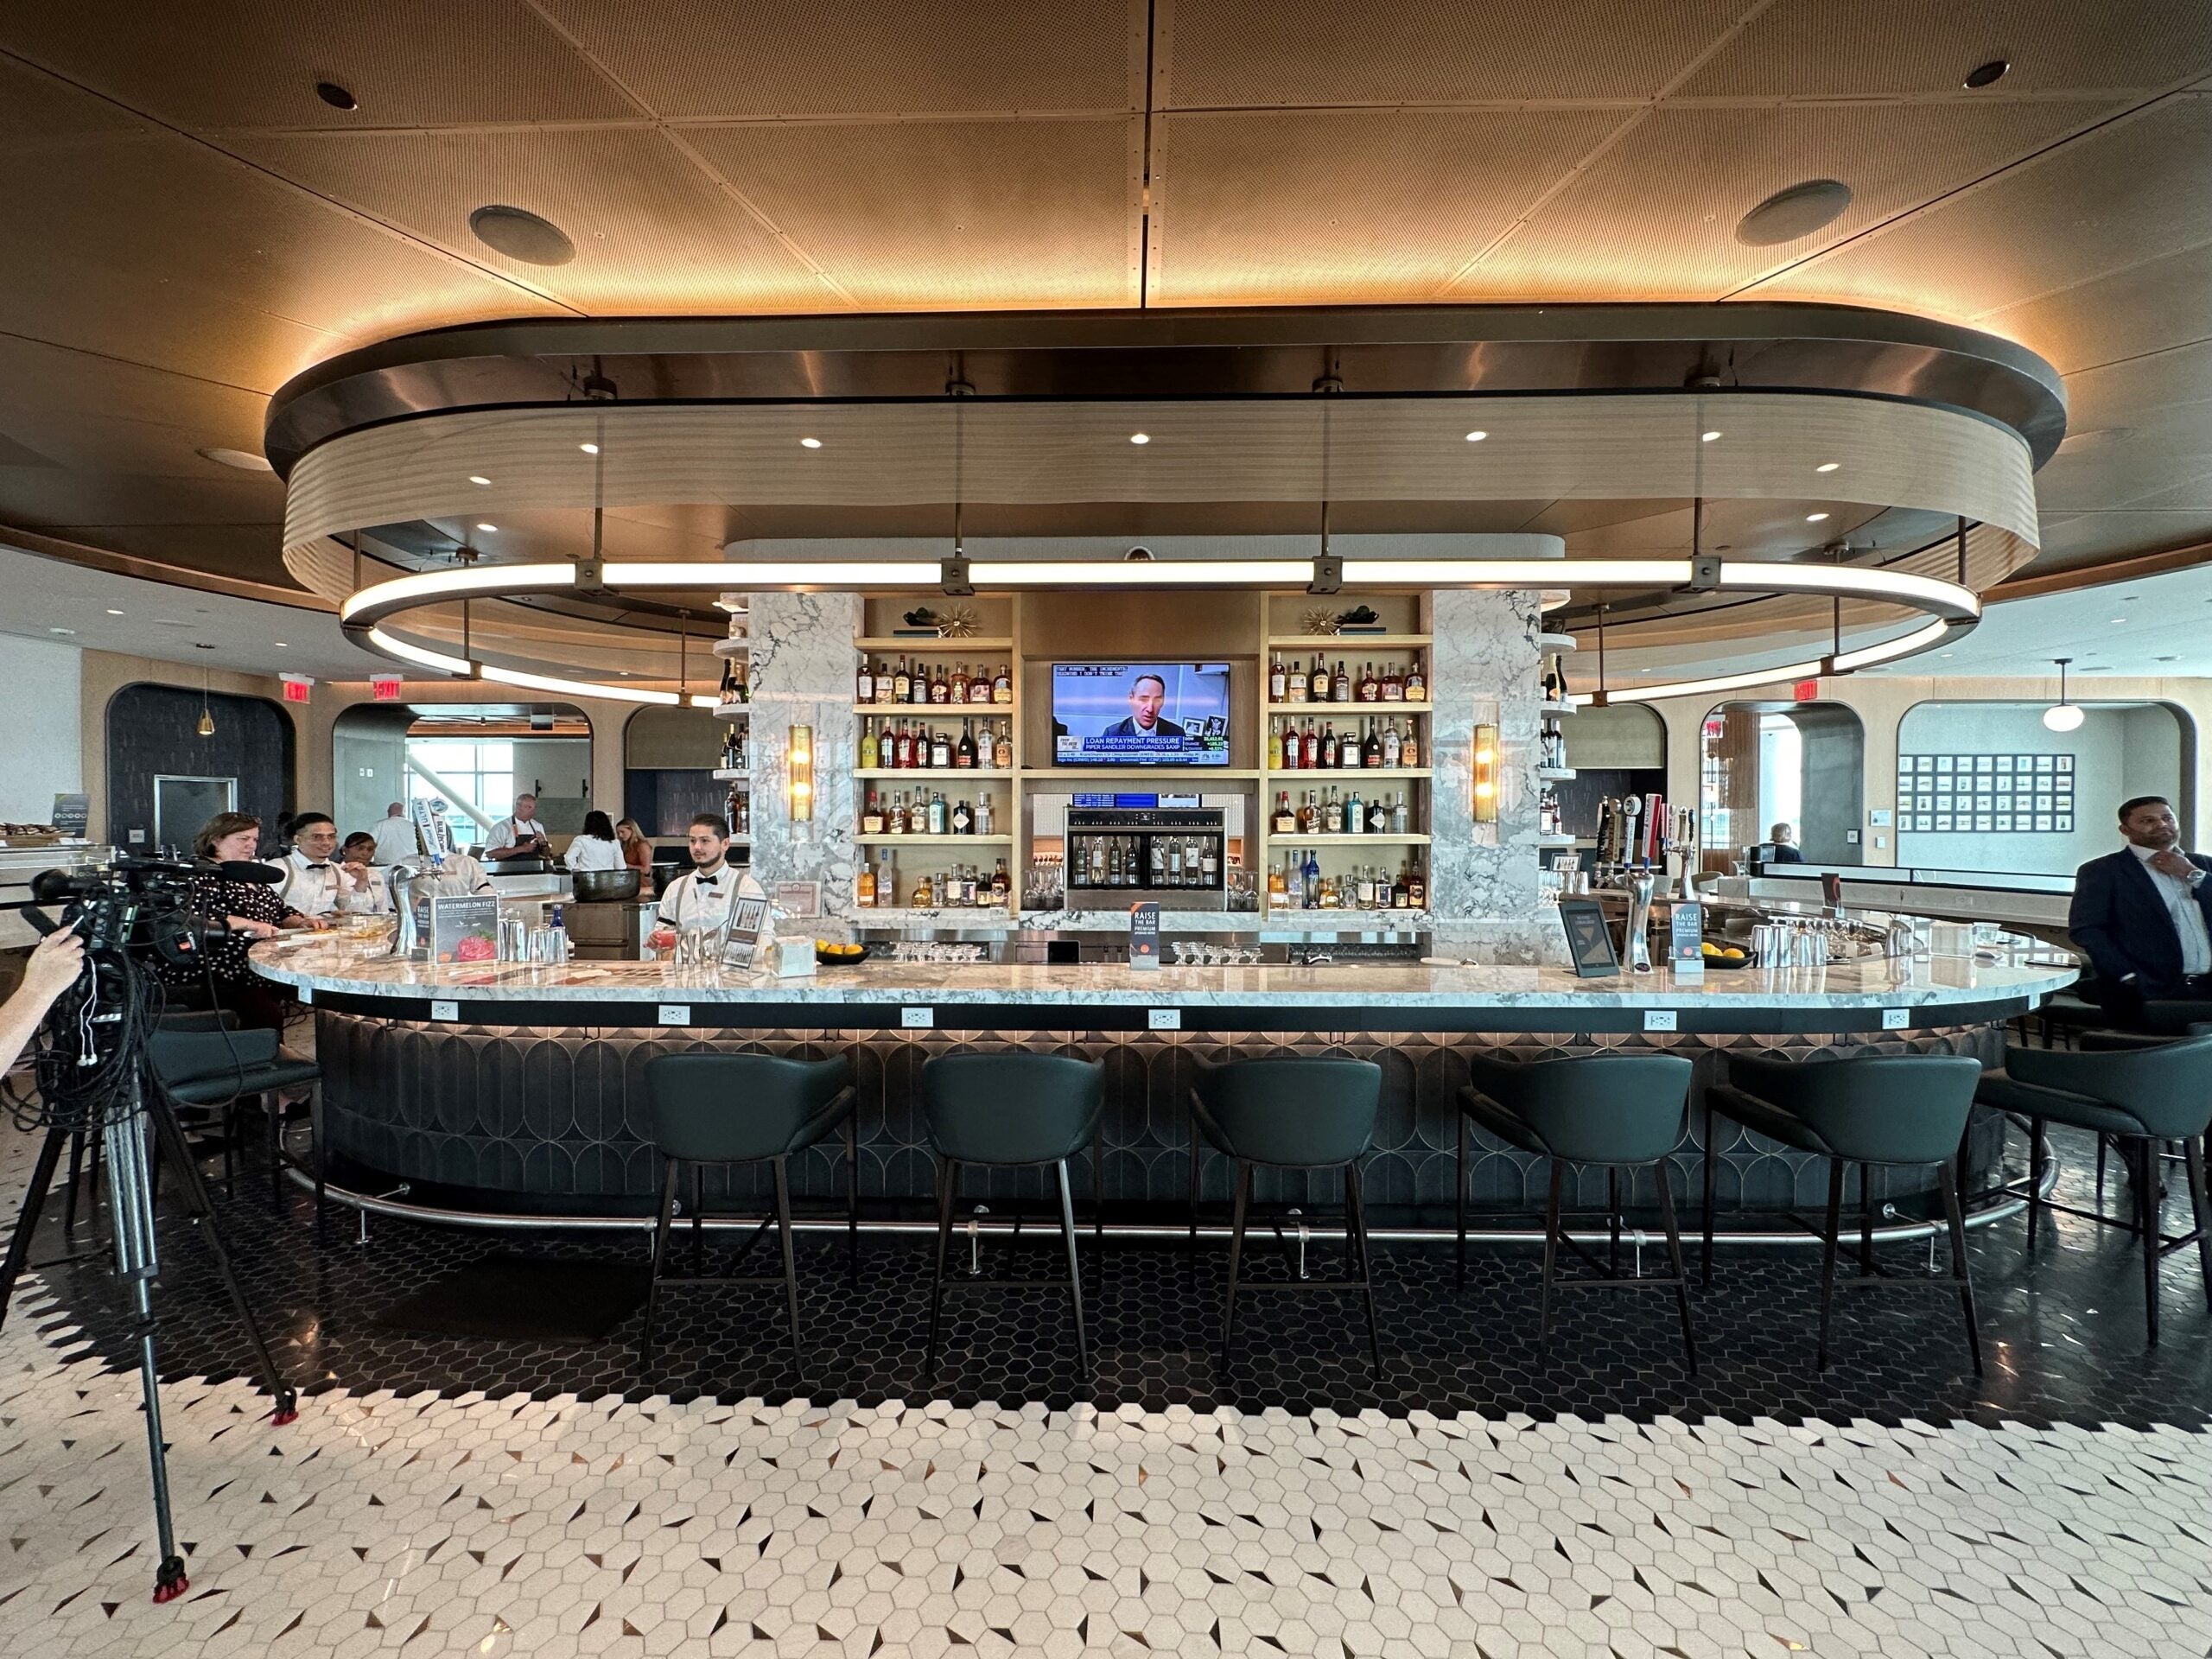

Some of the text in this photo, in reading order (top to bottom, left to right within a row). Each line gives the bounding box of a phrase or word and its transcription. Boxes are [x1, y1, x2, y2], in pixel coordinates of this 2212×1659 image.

[416, 800, 430, 823] ULTRA
[437, 901, 481, 910] WATERMELON
[1675, 912, 1698, 921] RAISE
